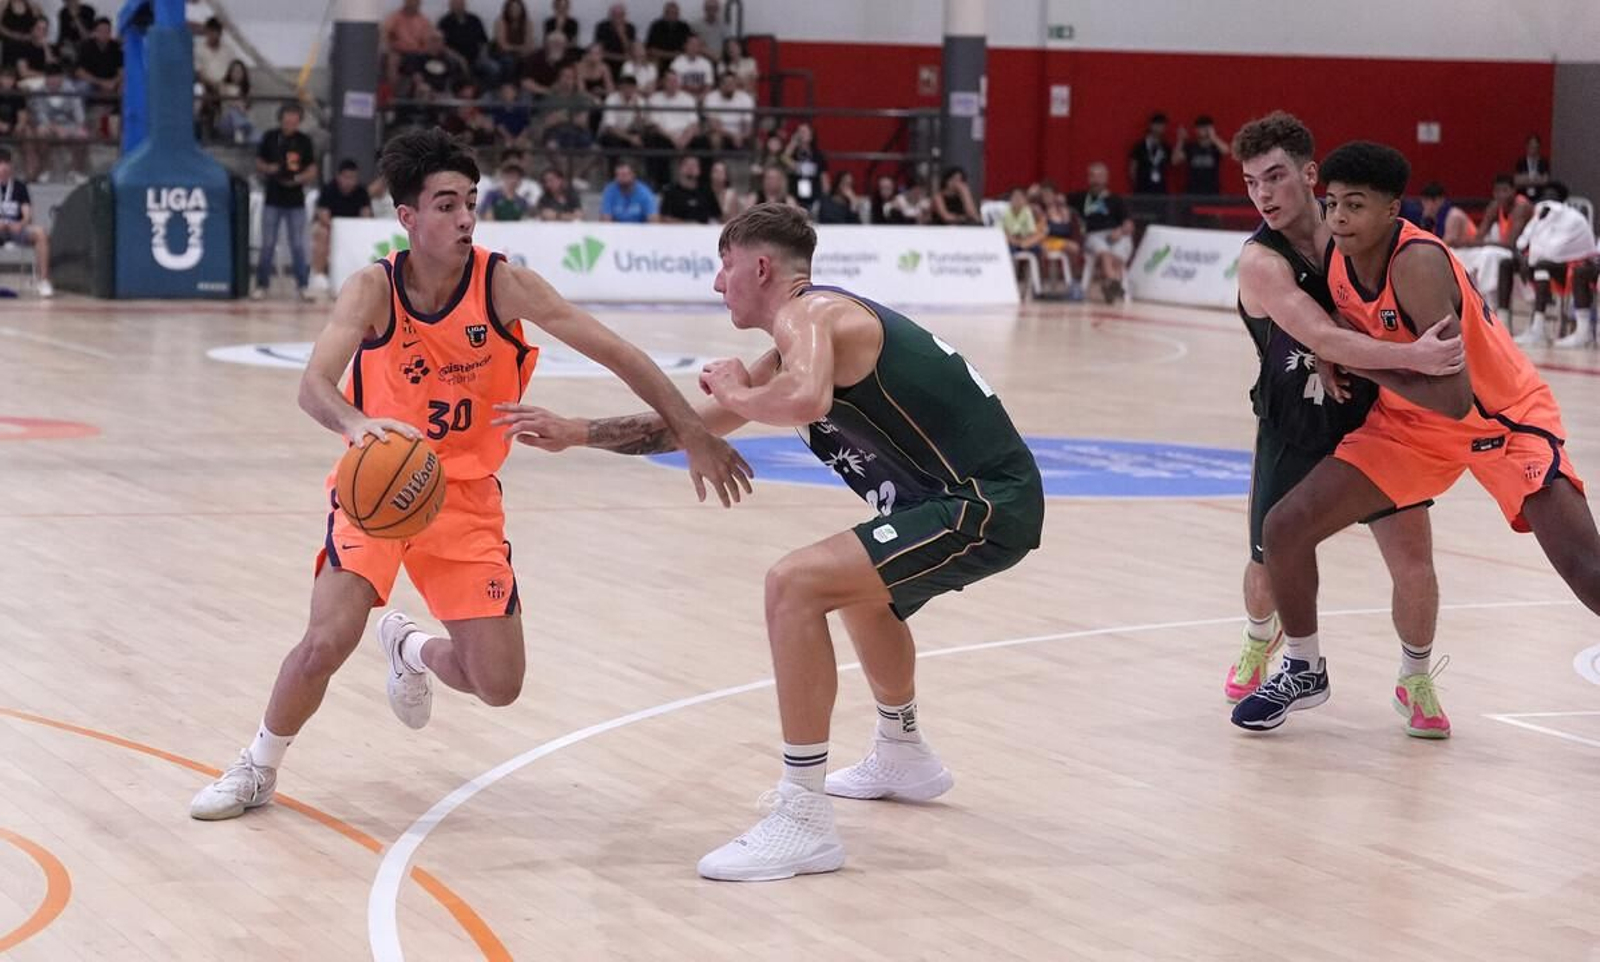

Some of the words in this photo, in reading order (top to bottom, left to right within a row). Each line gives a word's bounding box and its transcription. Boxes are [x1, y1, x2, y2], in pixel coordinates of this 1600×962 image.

[146, 187, 207, 212] LIGA
[614, 251, 714, 277] Unicaja
[427, 398, 472, 440] 30
[391, 451, 437, 511] Wilson
